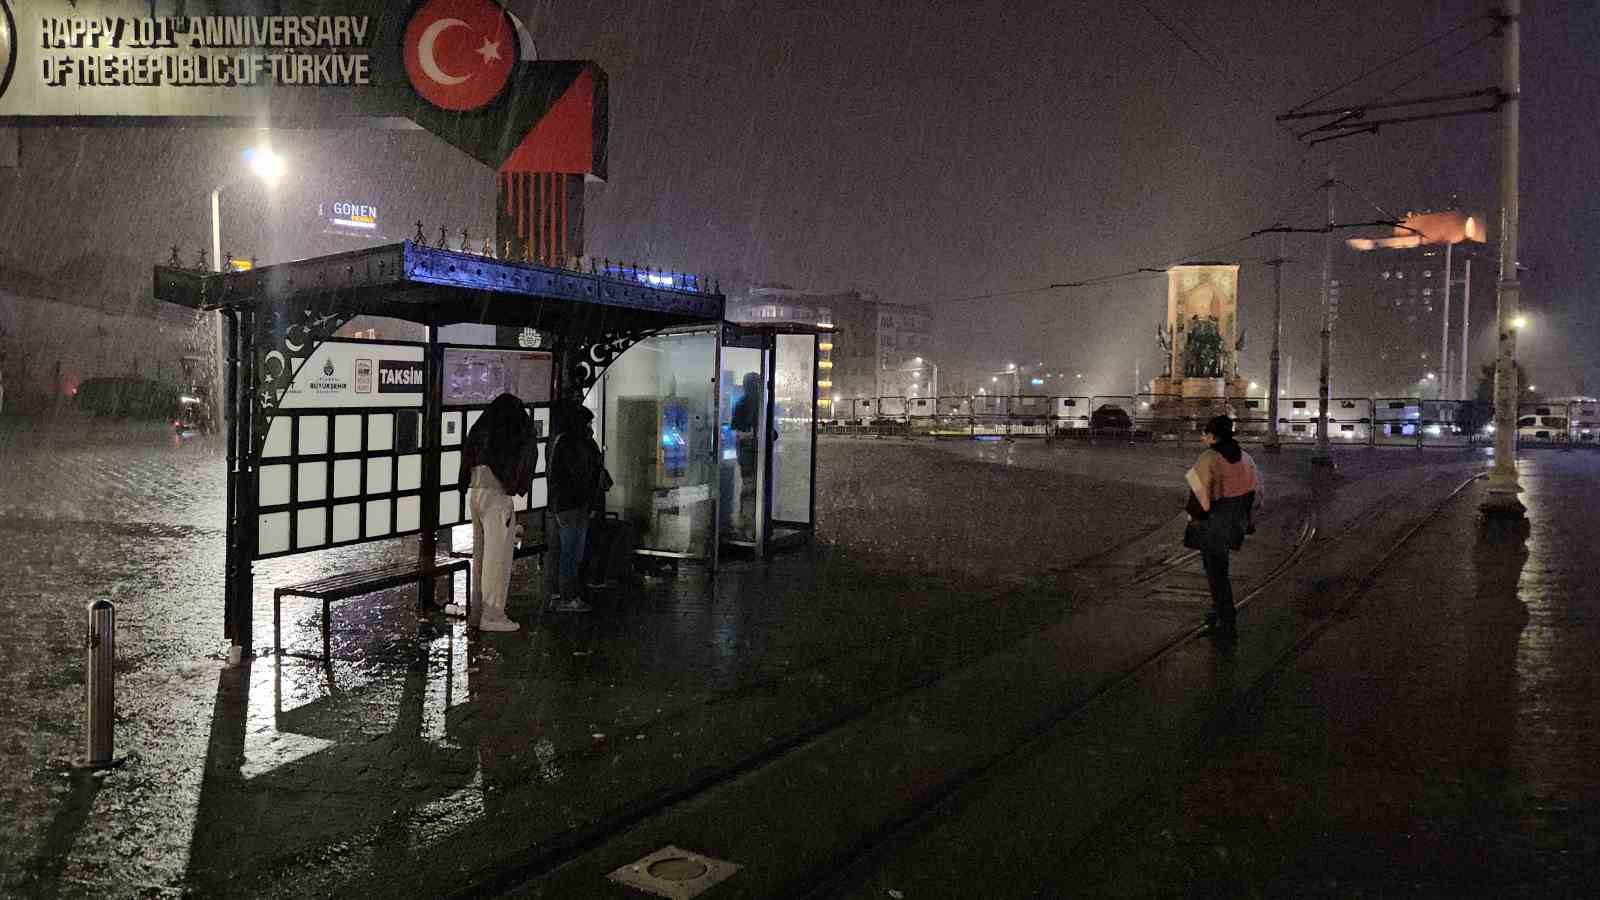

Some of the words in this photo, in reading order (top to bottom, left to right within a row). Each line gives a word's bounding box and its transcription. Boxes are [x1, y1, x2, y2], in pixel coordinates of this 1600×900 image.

[41, 16, 119, 46] HAPPY
[189, 15, 368, 46] ANNIVERSARY
[41, 55, 67, 84] OF
[69, 55, 113, 84] THE
[117, 55, 230, 84] REPUBLIC
[233, 54, 264, 84] OF
[266, 47, 369, 84] TÜRKİYE
[380, 366, 423, 385] TAKSİM
